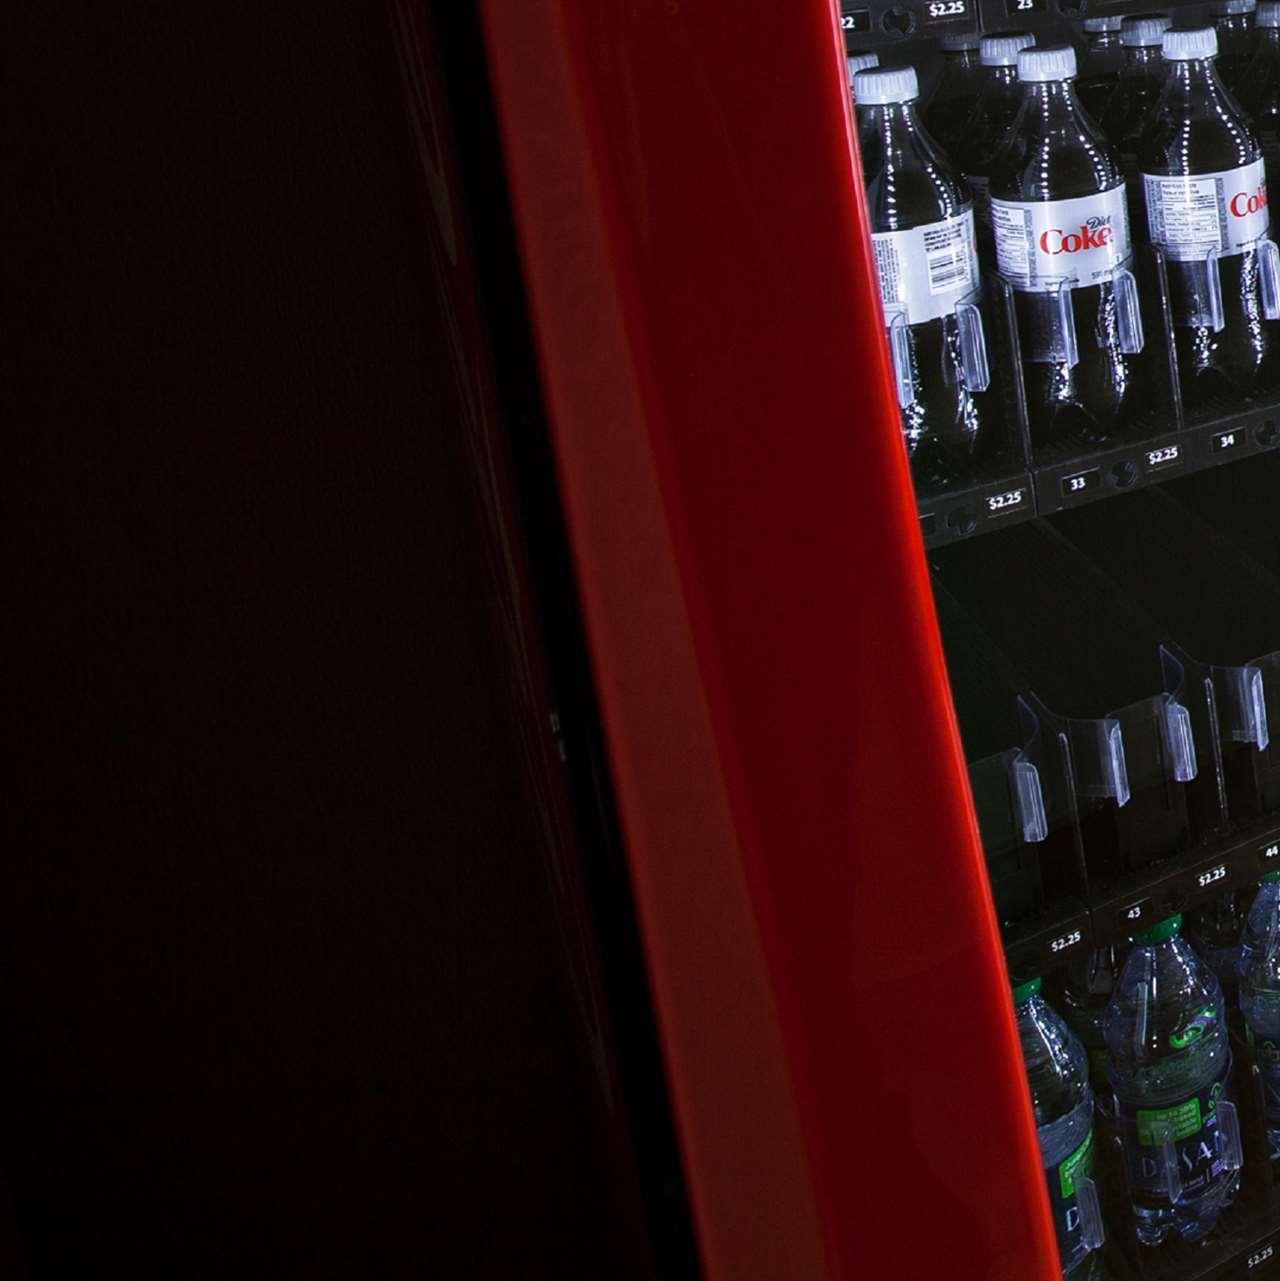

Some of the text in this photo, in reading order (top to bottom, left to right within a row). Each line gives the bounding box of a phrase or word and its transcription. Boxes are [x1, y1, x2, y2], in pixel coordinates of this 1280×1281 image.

[929, 1, 965, 16] $2.25
[1230, 186, 1268, 218] Cok
[1040, 225, 1111, 255] Coke
[1220, 435, 1235, 448] 34
[1148, 447, 1178, 464] $2.25
[1070, 477, 1085, 491] 33
[988, 492, 1022, 510] $2.25
[1266, 845, 1279, 858] 44
[1199, 865, 1226, 886] $2.25
[1128, 906, 1141, 919] 43
[1051, 931, 1081, 952] $2.25
[1247, 1247, 1274, 1268] $2.25
